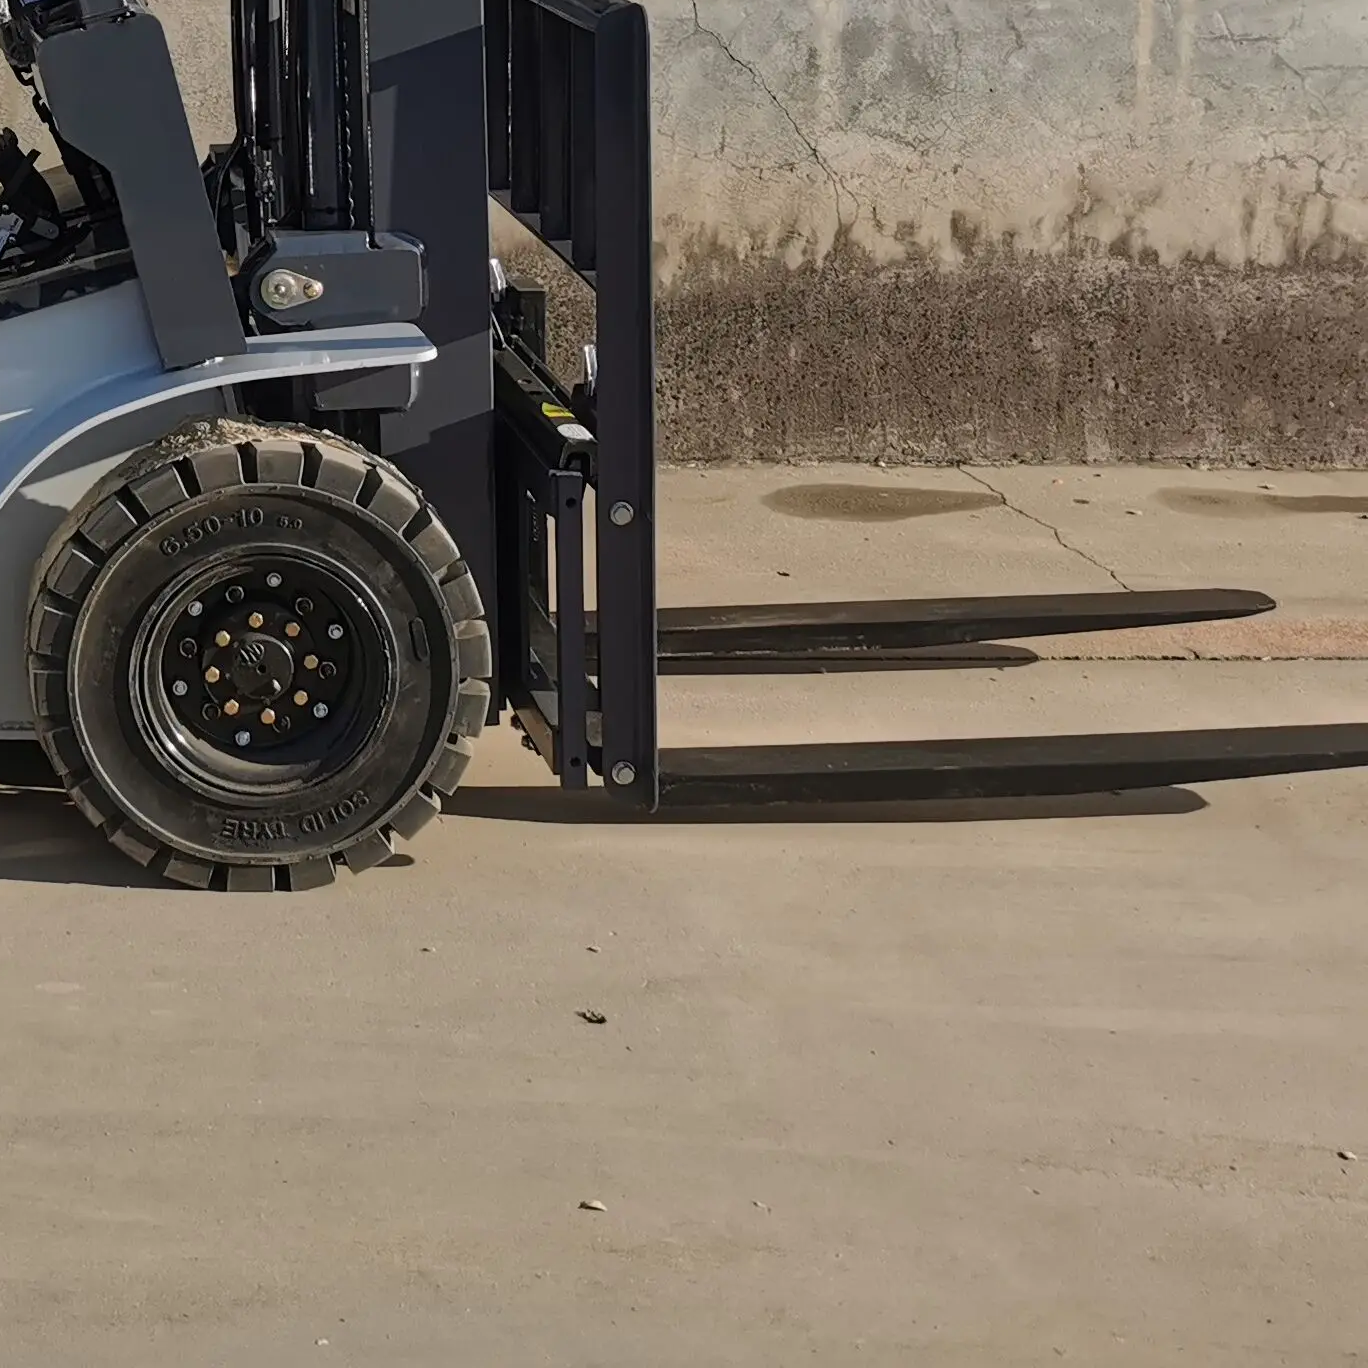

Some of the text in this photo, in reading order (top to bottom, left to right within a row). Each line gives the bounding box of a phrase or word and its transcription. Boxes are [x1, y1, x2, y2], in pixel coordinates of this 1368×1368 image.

[160, 507, 265, 557] 6.50-10
[221, 789, 371, 840] SOLID TYRE
